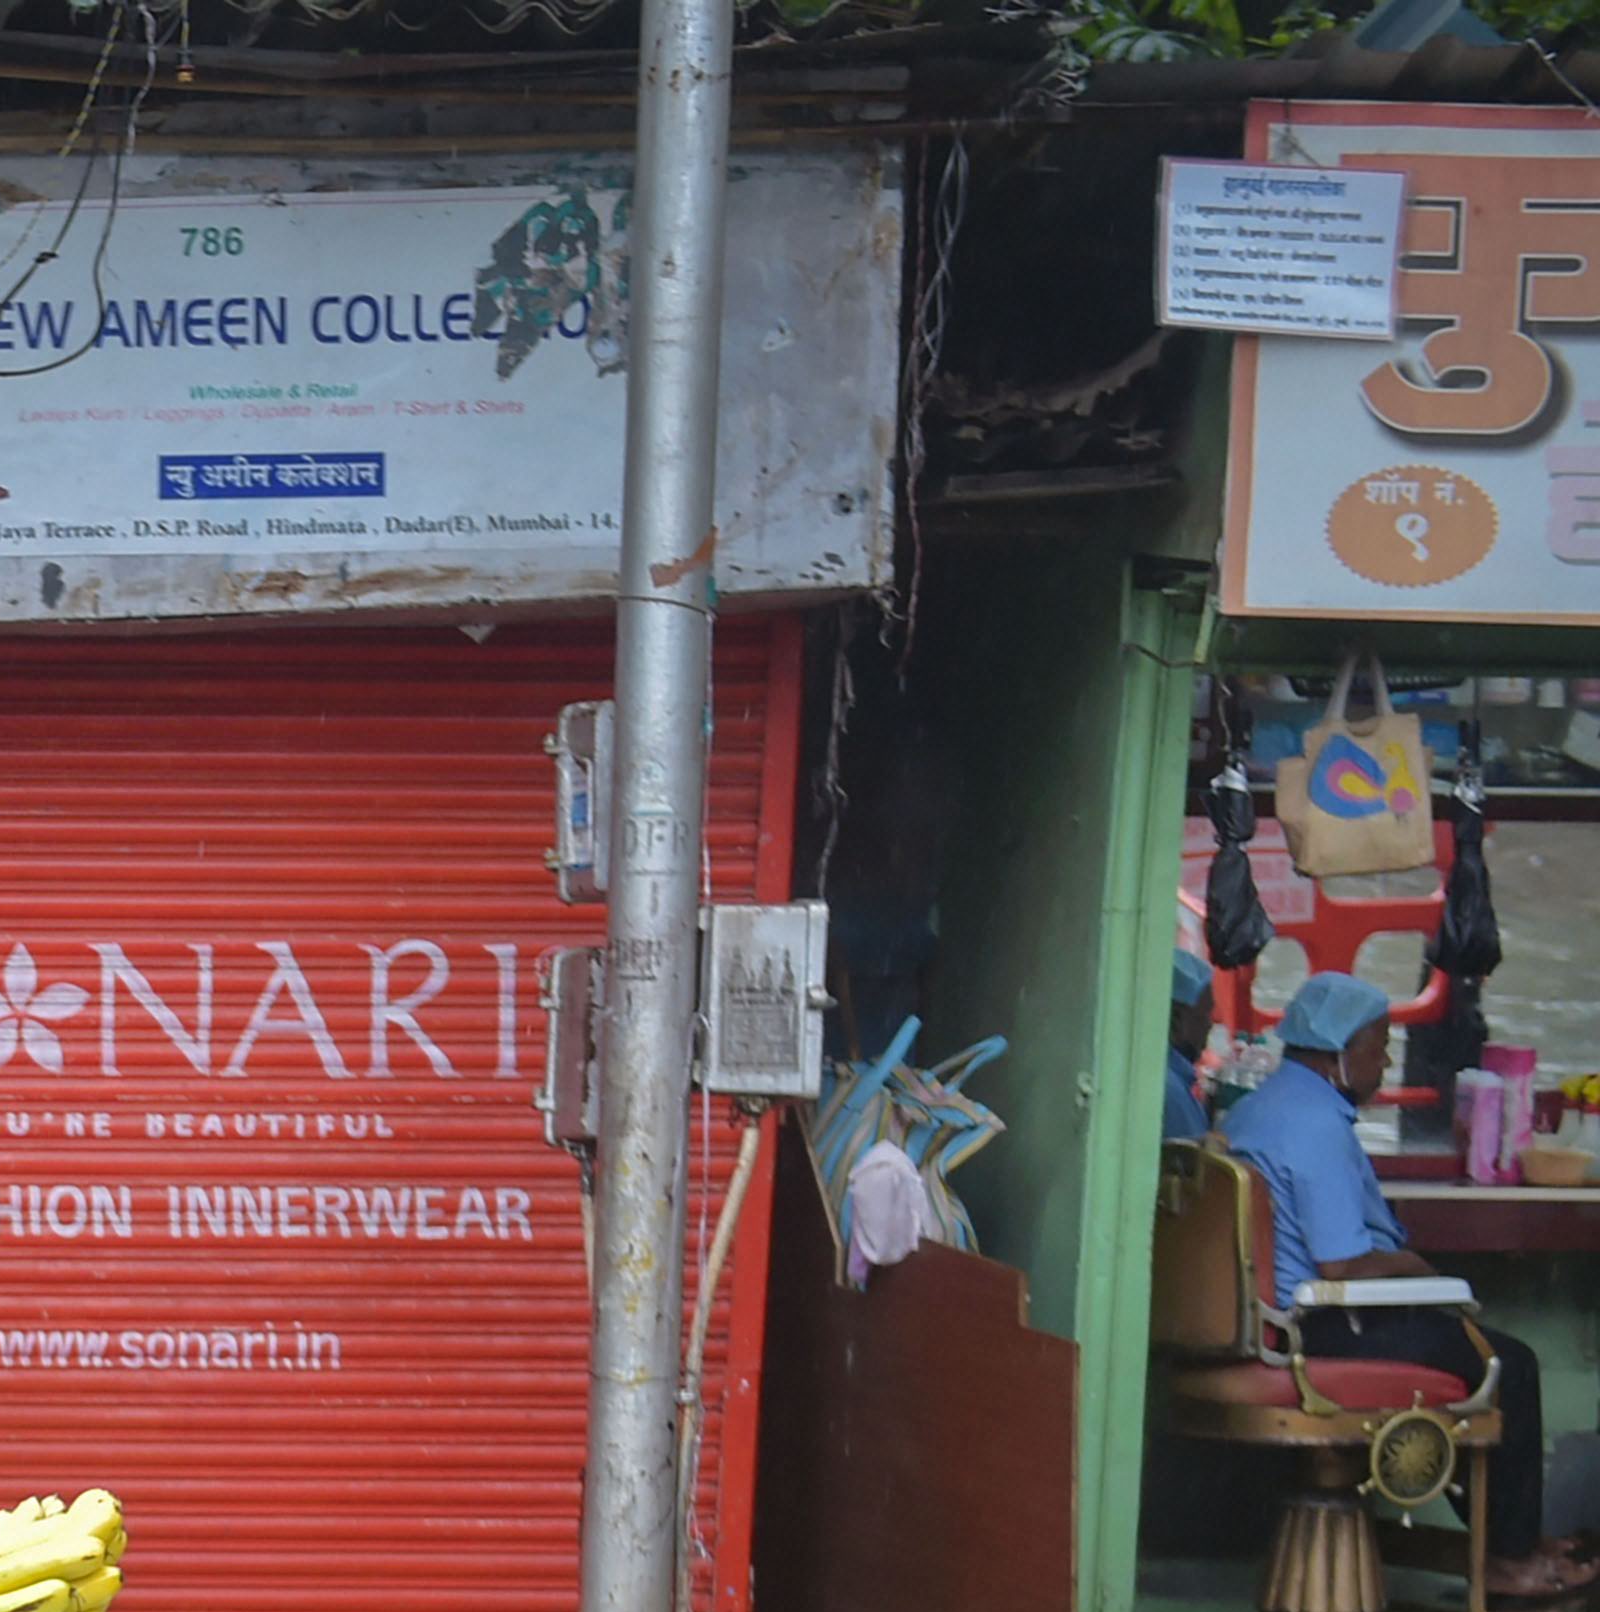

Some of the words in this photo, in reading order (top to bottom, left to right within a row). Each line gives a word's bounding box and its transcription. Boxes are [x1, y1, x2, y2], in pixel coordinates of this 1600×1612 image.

[180, 227, 244, 256] 786
[96, 297, 288, 348] AMEEN
[201, 456, 273, 489] अमीन
[1364, 472, 1420, 505] शॉप
[43, 520, 115, 539] Terrace
[133, 519, 191, 537] D.S.P.
[197, 518, 248, 536] Road
[266, 517, 368, 536] Hindmata
[487, 513, 572, 533] Mumbai
[146, 1112, 396, 1139] BEAUTIFUL
[167, 1185, 534, 1242] INNERWEAR
